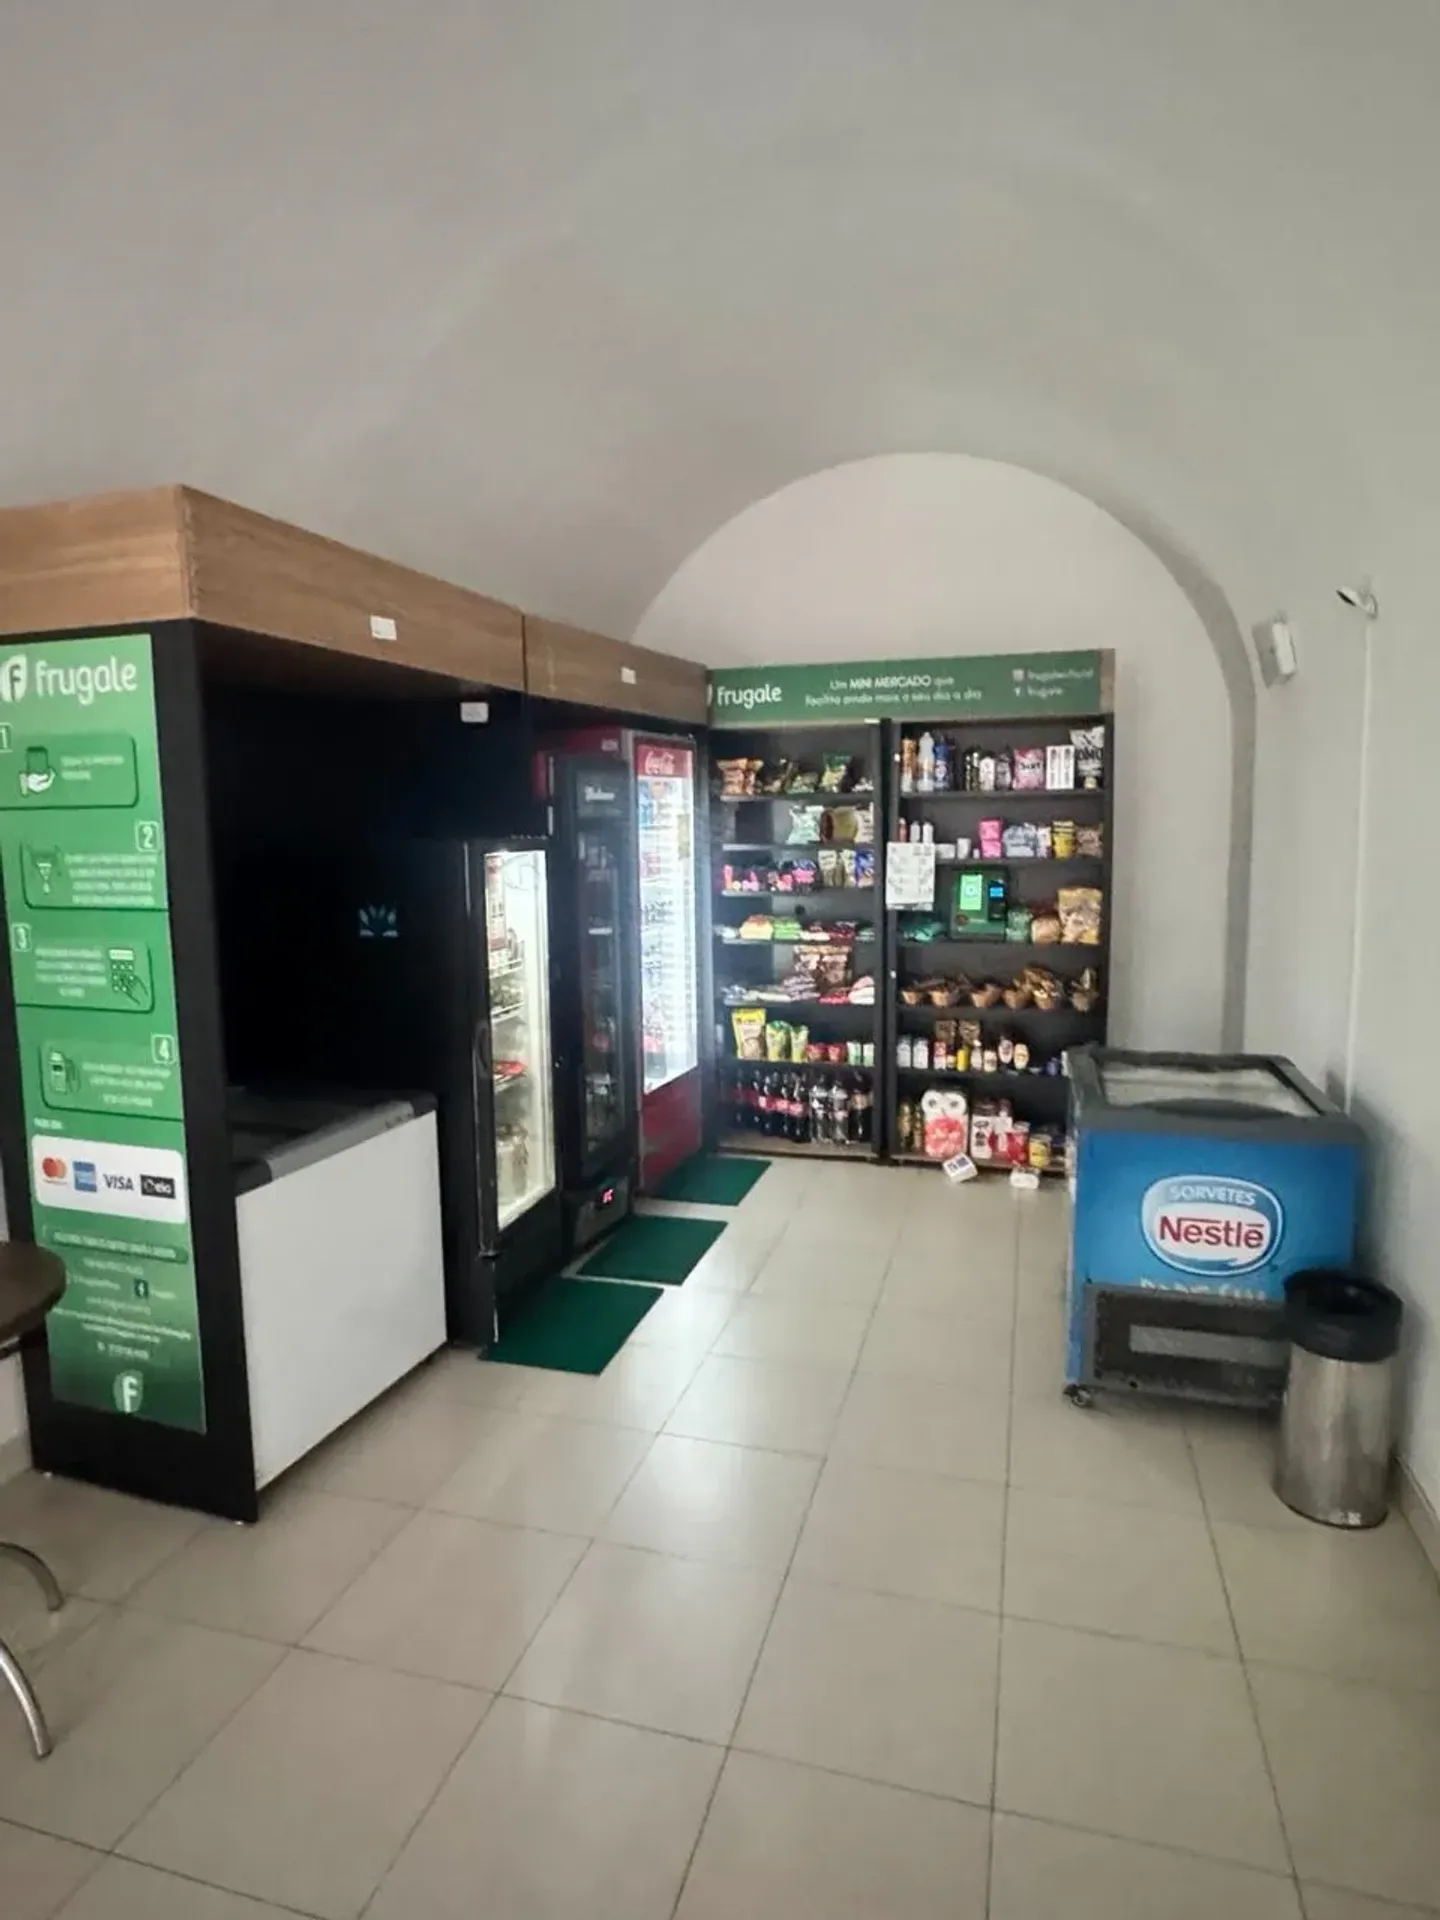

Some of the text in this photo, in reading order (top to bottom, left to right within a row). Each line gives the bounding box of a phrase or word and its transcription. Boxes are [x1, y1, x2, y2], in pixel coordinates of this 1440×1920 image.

[36, 654, 138, 706] frugale
[850, 678, 872, 690] MINI
[875, 675, 931, 688] MERCADO
[717, 683, 782, 709] frugale
[142, 825, 153, 848] 2
[103, 1174, 134, 1192] VISA
[1170, 1185, 1257, 1206] SORVETES
